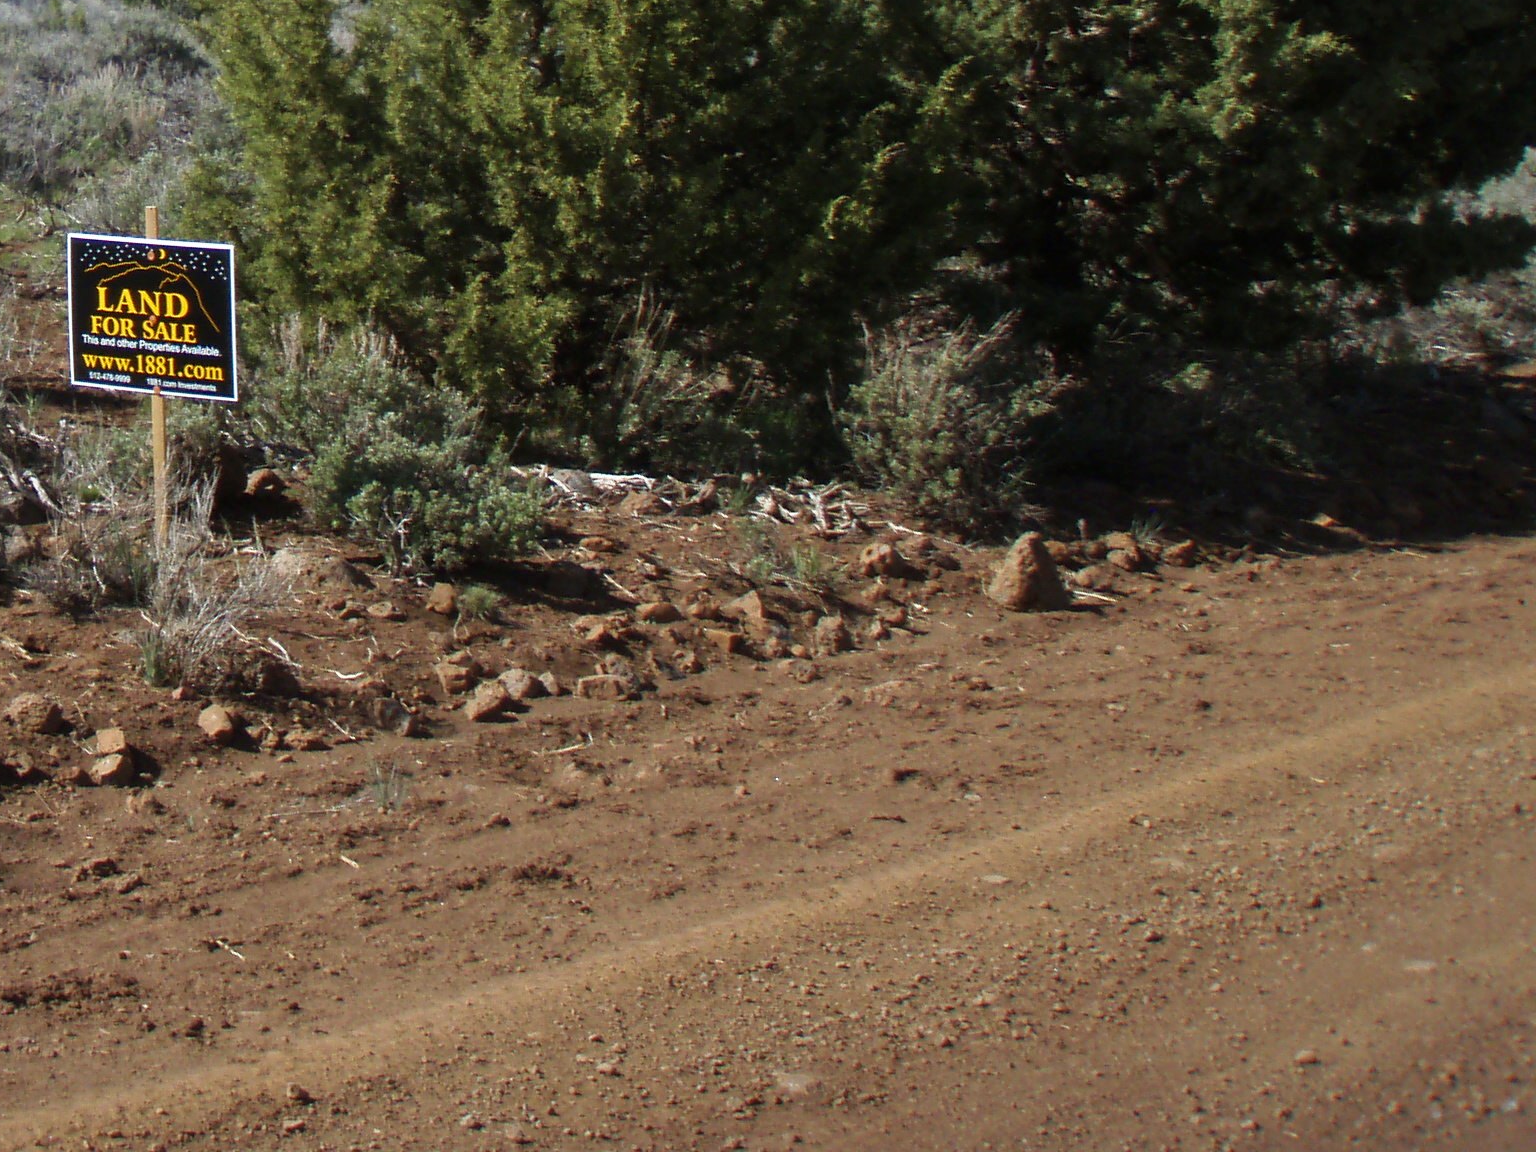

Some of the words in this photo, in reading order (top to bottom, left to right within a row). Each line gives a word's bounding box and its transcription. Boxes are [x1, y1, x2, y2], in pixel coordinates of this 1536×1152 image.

[96, 286, 189, 319] LAND
[90, 315, 136, 338] FOR
[142, 319, 197, 343] SALE
[82, 333, 100, 345] This
[100, 336, 116, 347] and
[116, 338, 138, 350] other
[139, 340, 180, 354] Properties
[82, 353, 224, 381] www.1881.com
